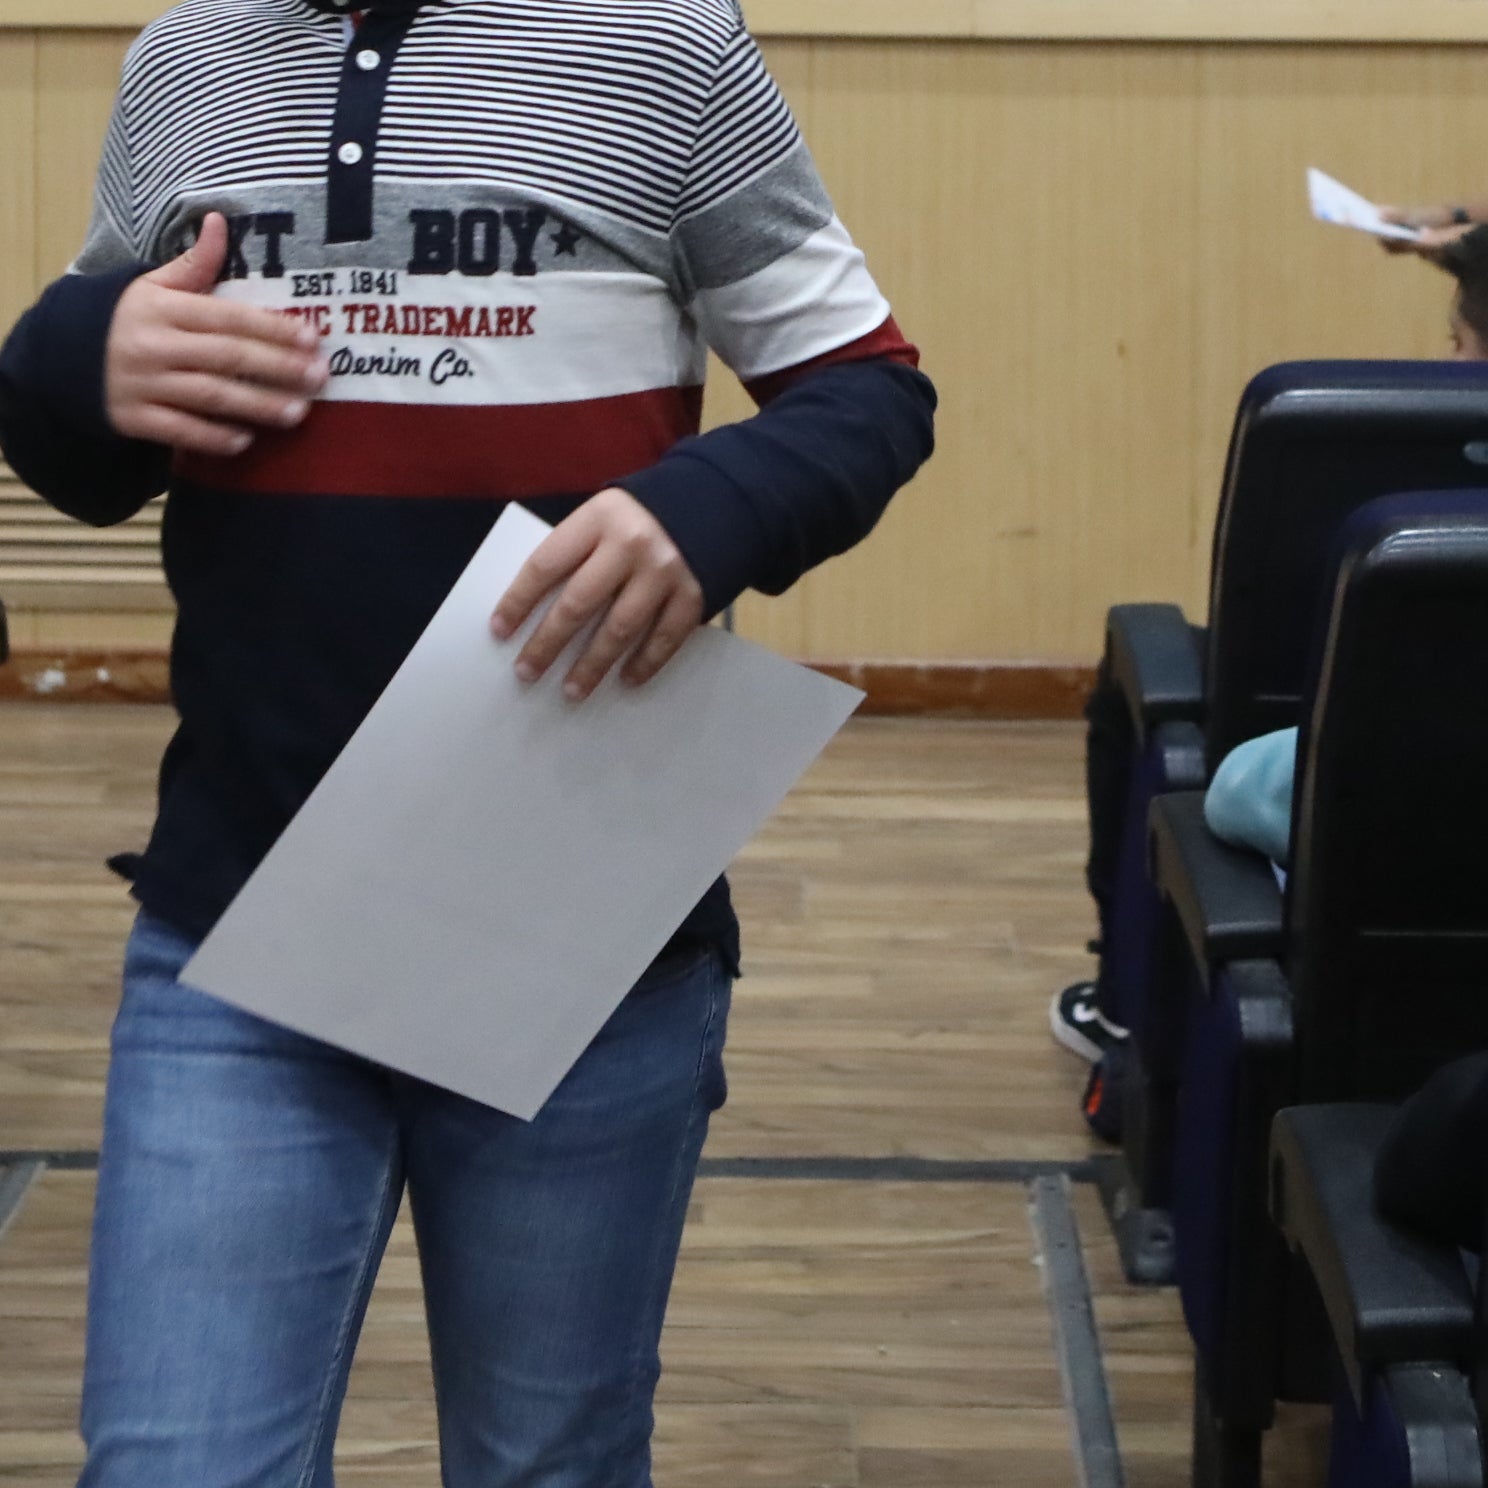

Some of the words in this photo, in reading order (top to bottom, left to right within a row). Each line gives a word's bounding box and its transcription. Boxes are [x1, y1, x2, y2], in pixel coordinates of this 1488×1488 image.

[408, 208, 546, 276] BOY
[292, 272, 342, 297] EST.
[350, 270, 397, 295] 1841
[342, 303, 536, 337] TRADEMARK
[329, 346, 420, 377] Denim
[429, 348, 474, 386] Co.
